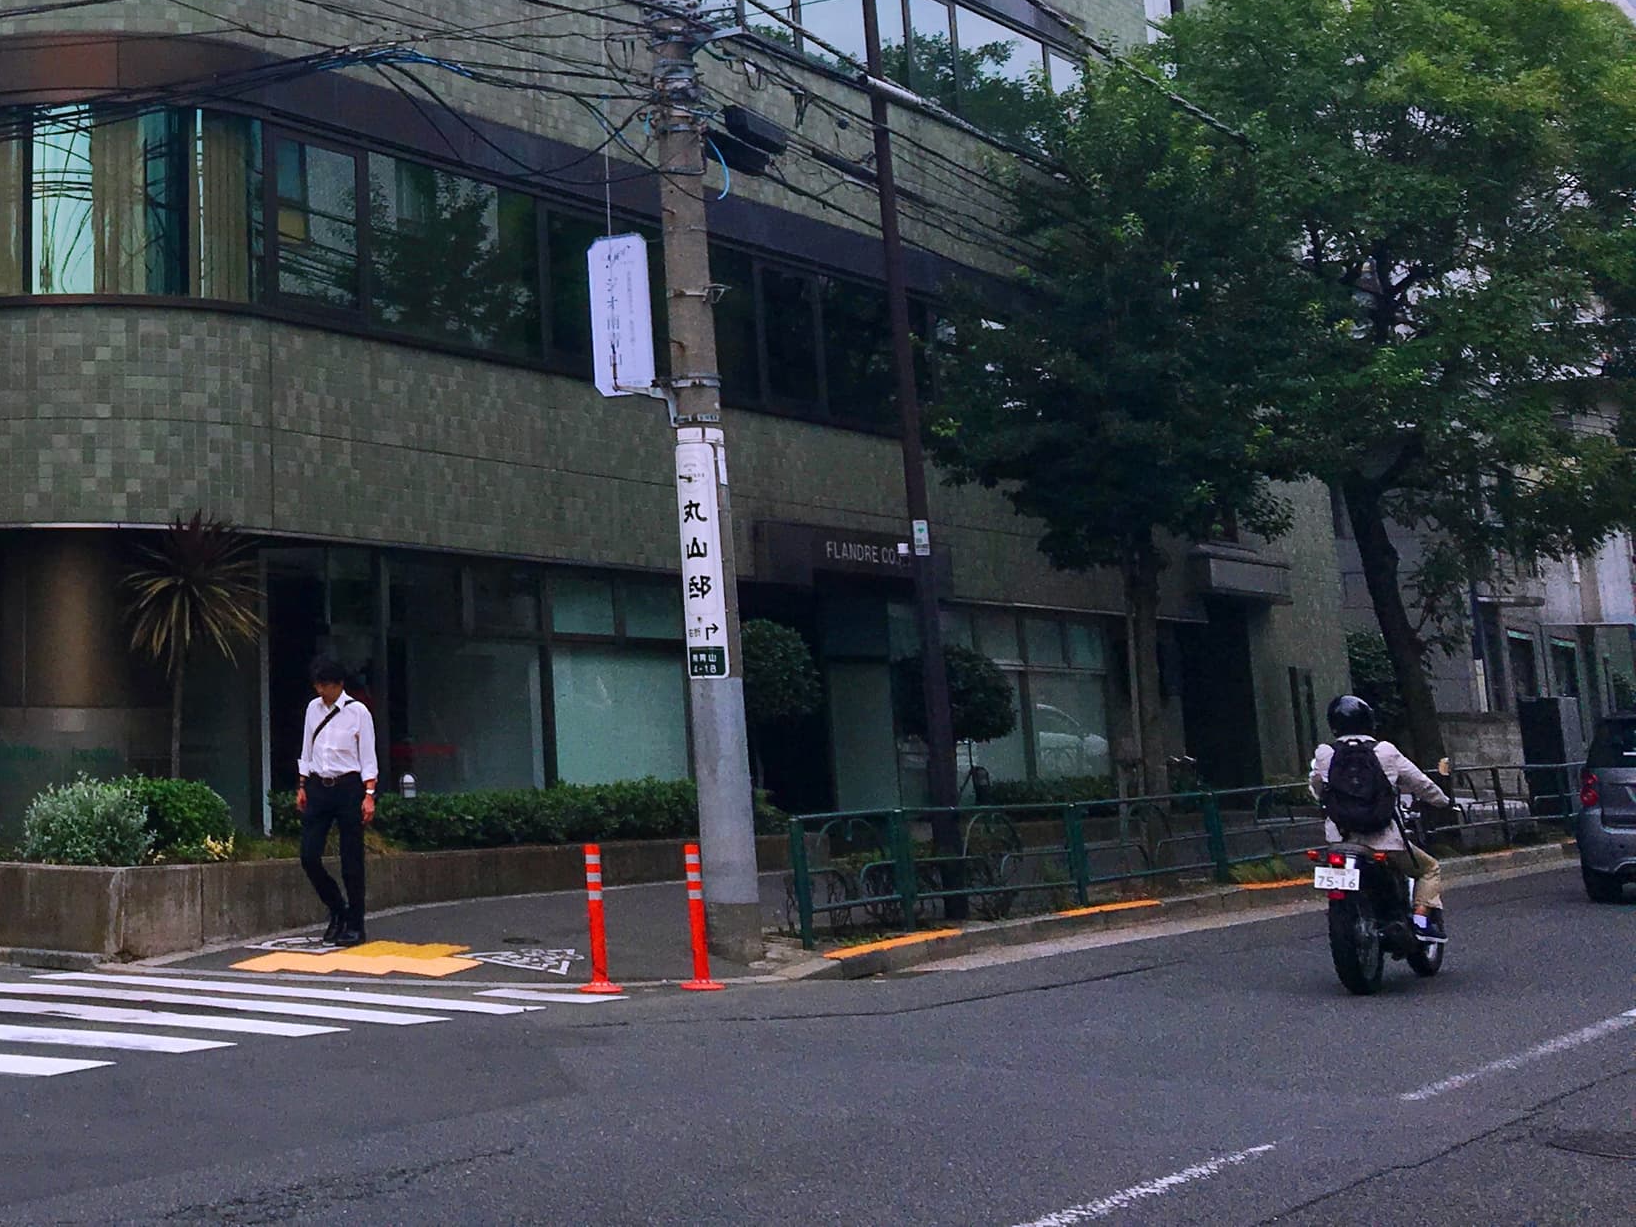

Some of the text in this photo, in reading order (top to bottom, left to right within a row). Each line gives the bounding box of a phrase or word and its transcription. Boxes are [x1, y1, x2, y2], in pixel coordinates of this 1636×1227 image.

[683, 499, 712, 599] 丸山邸
[825, 540, 880, 564] FLANDRE
